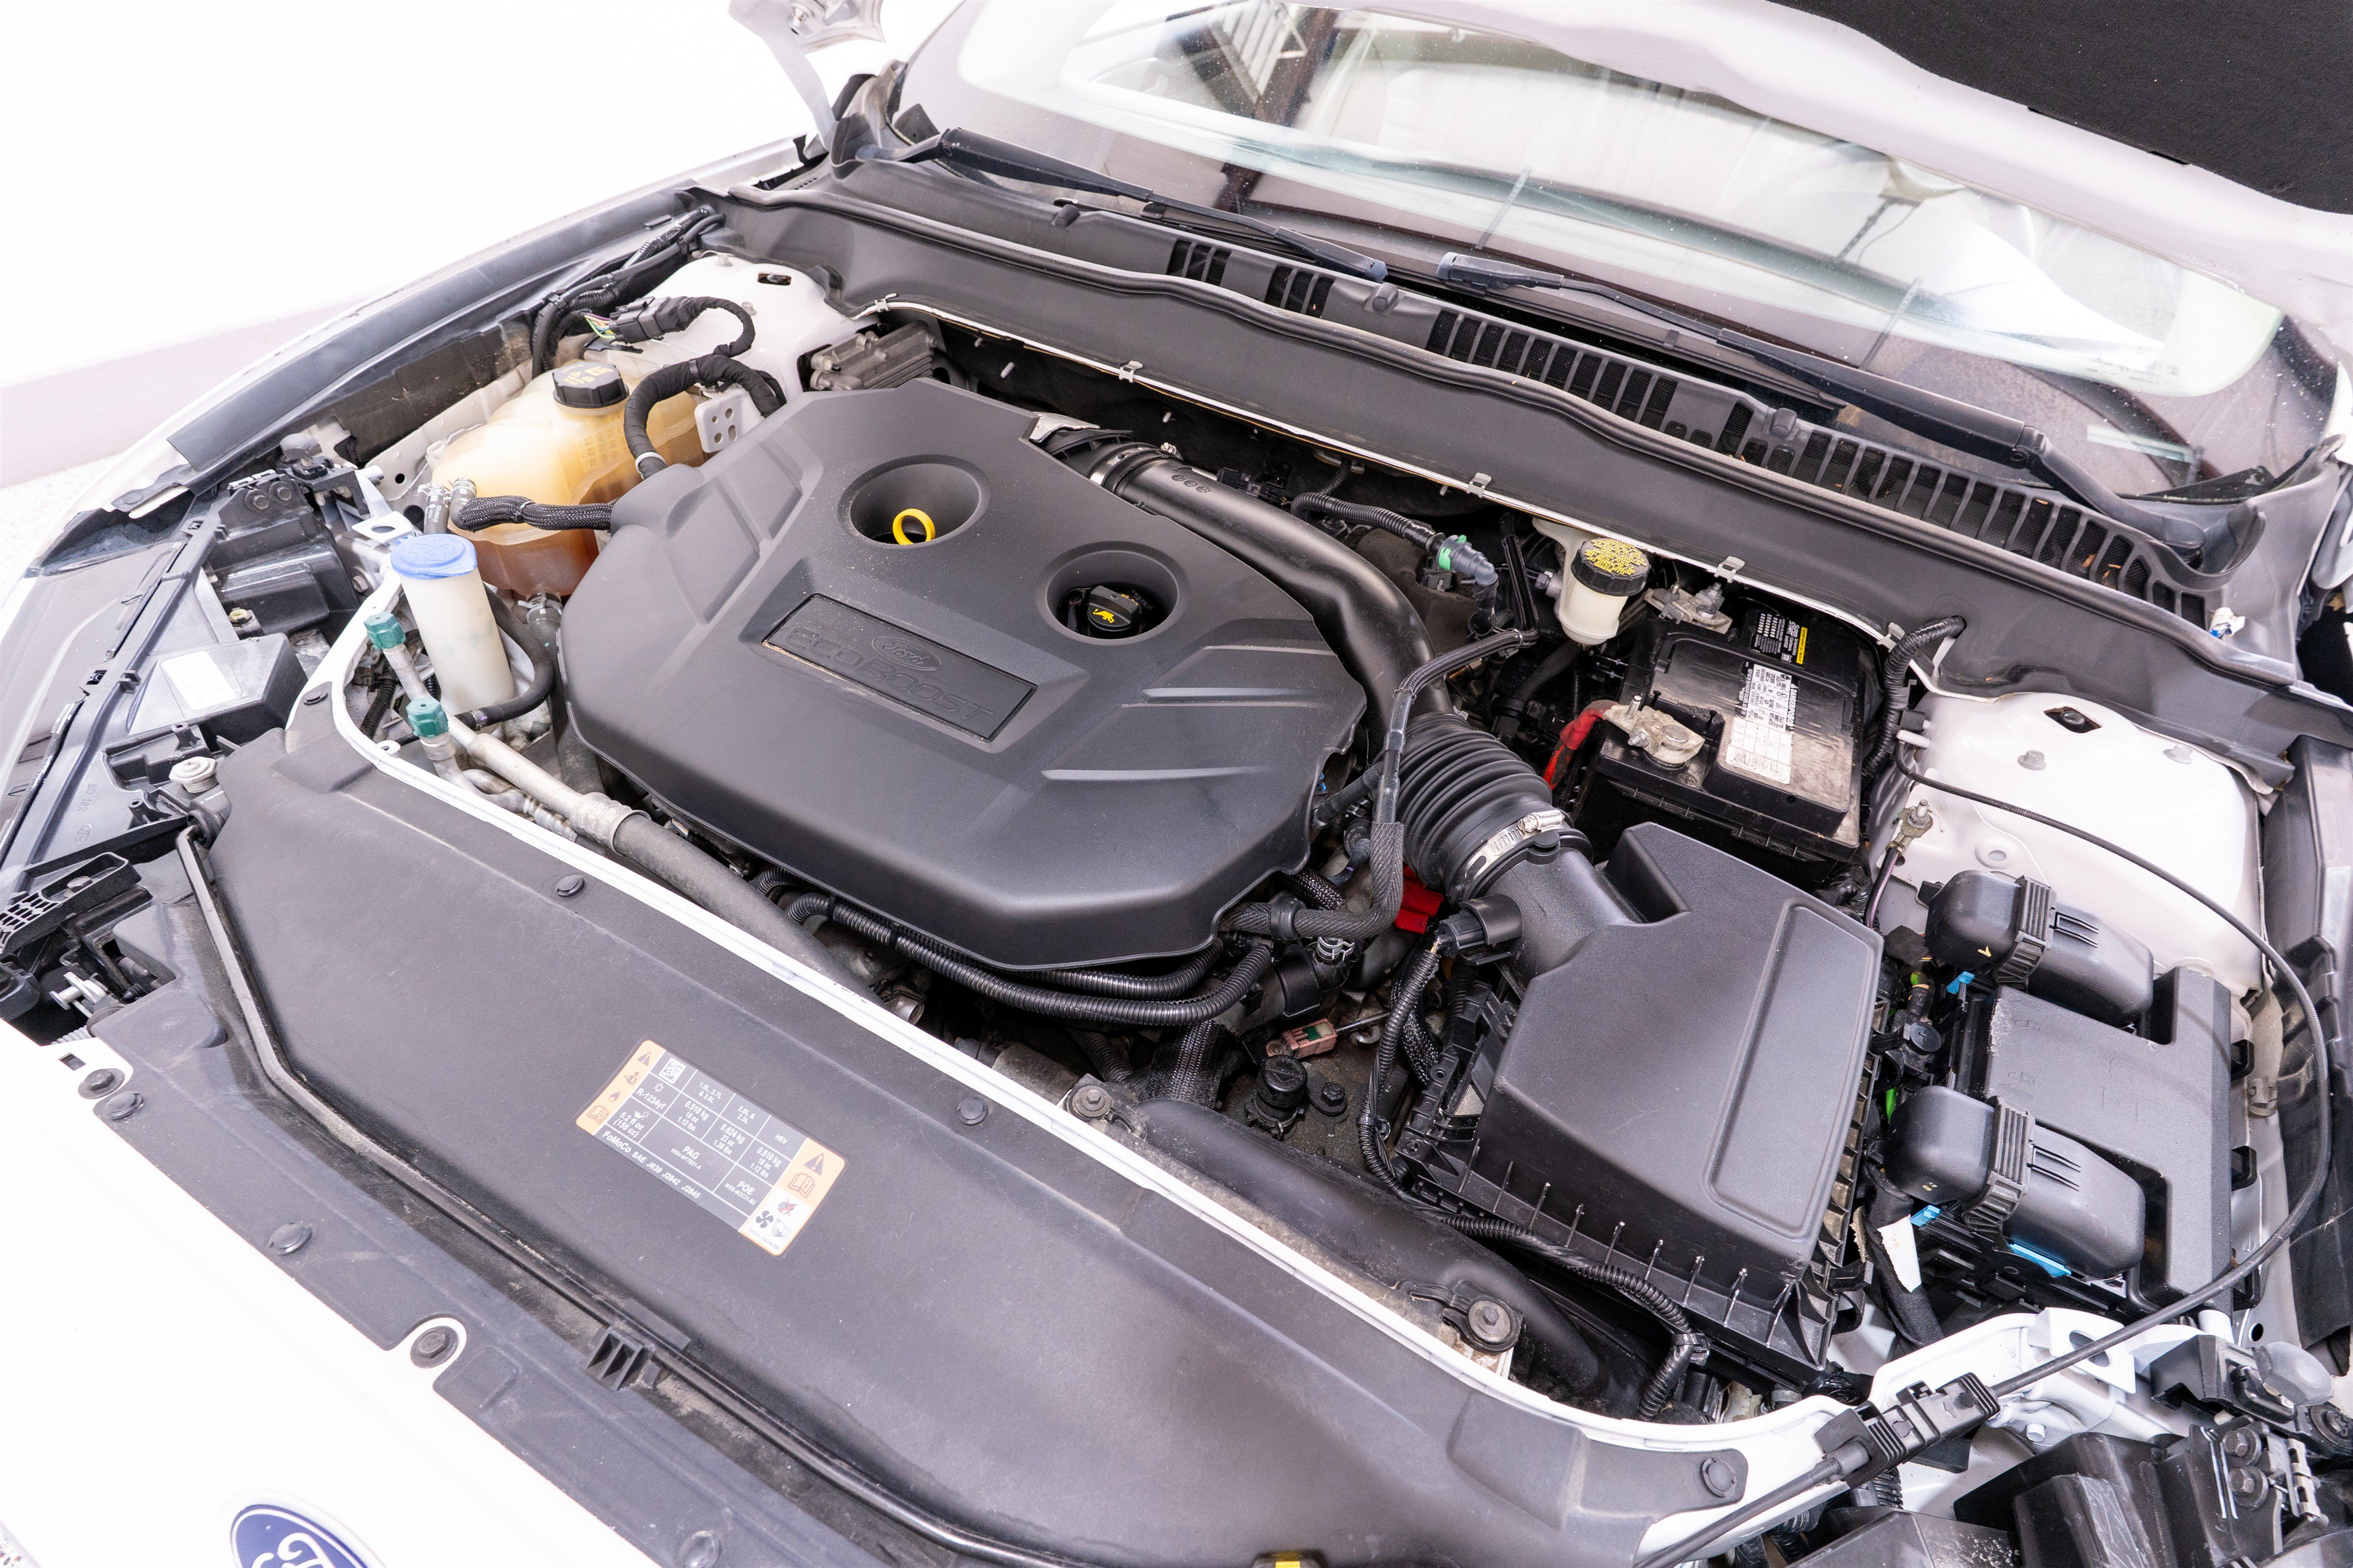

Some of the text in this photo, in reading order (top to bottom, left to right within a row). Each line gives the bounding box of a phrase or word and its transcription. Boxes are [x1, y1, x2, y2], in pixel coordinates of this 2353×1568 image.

[699, 1082, 722, 1099] 1.5L, 2.7L
[703, 1093, 714, 1103] 3.0L
[635, 1088, 666, 1109] R-1234yf
[619, 1111, 631, 1121] 5.2
[684, 1100, 709, 1121] 0.510 kg
[737, 1106, 749, 1116] 2.0L
[677, 1116, 696, 1131] 1.12 lbs
[736, 1113, 749, 1124] 2.5L
[612, 1118, 639, 1138] (155 cc)
[720, 1123, 745, 1144] 0.624 kg
[774, 1134, 788, 1144] HEV
[682, 1145, 700, 1159] PAG
[713, 1140, 732, 1154] 1.38 lbs
[601, 1130, 701, 1198] FoMoCo SAE J639 J2842 J2845
[757, 1146, 782, 1167] 0.510 kg
[750, 1163, 769, 1177] 1.12 lbs
[736, 1180, 755, 1195] POE
